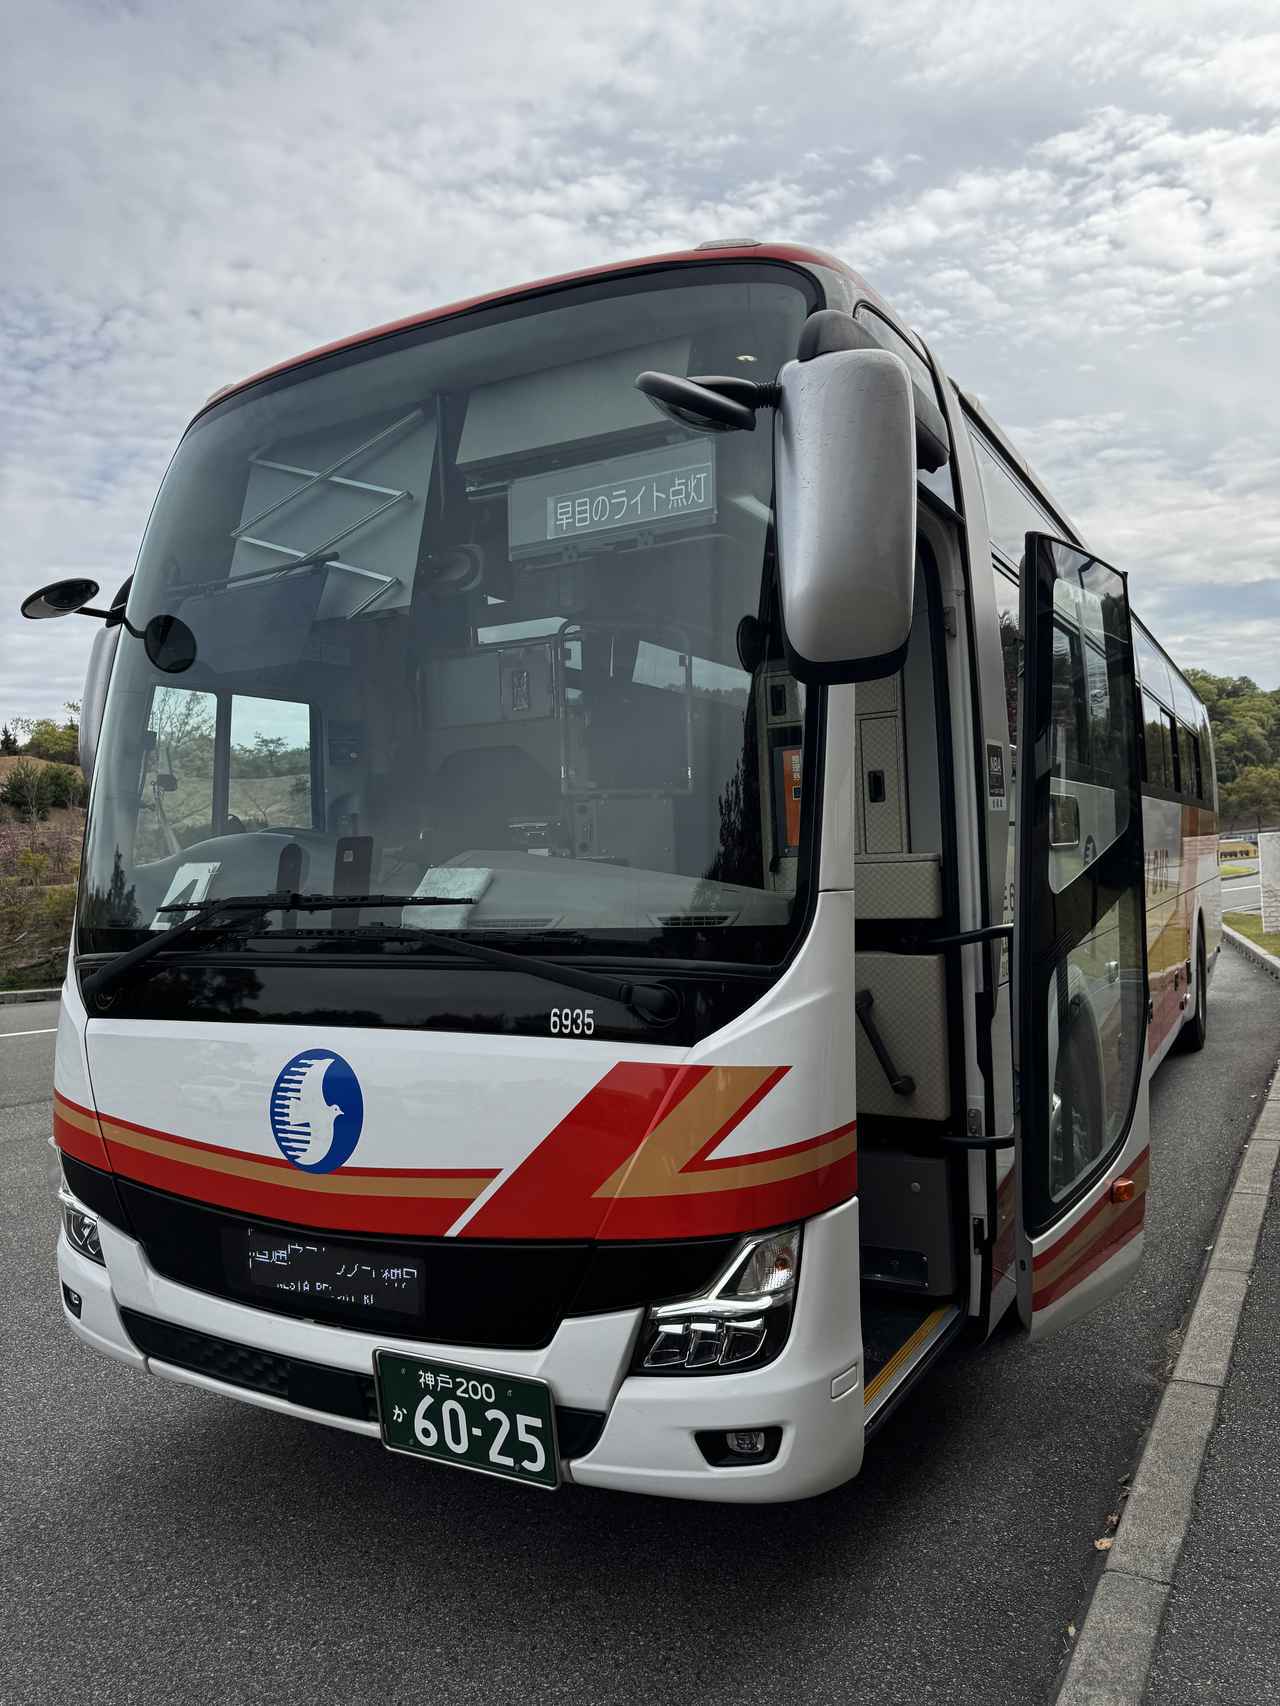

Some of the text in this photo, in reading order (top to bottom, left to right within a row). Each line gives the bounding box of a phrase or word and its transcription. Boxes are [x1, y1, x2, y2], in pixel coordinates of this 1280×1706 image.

[556, 473, 708, 530] 早目のライト点灯
[550, 1008, 595, 1035] 6935
[392, 1395, 546, 1473] か 60-25
